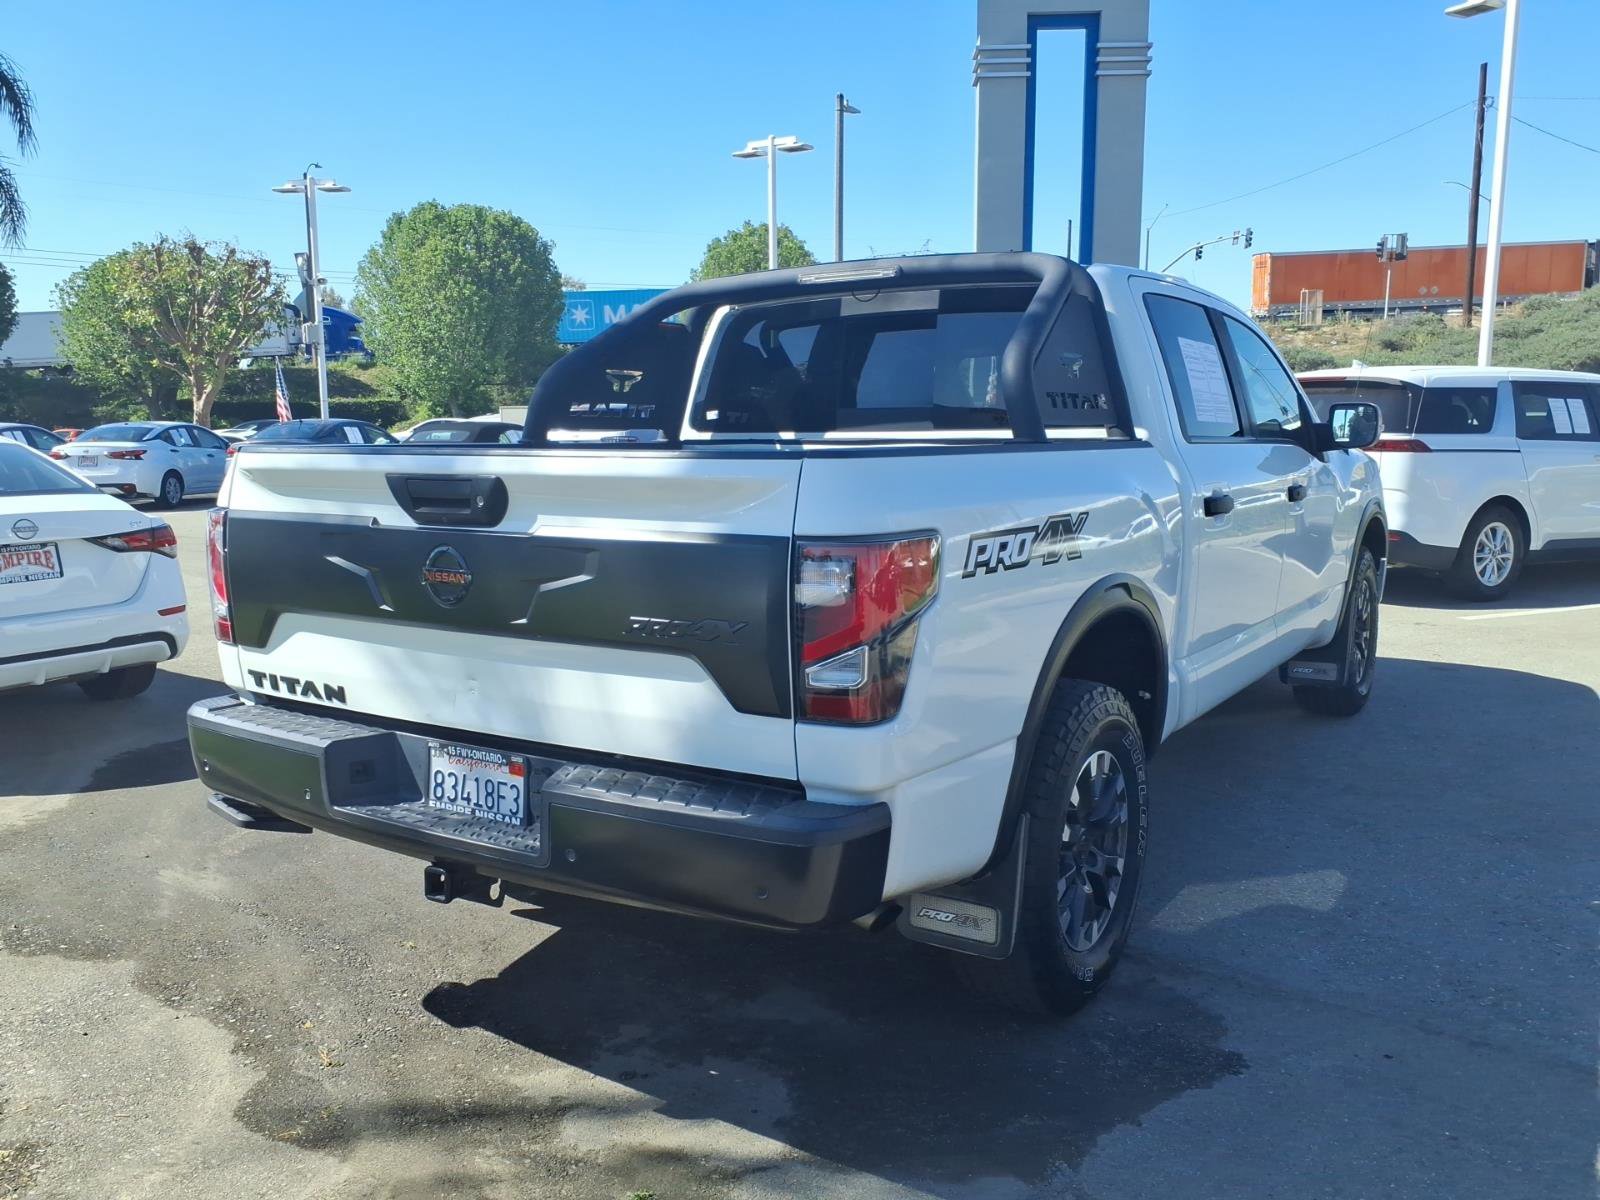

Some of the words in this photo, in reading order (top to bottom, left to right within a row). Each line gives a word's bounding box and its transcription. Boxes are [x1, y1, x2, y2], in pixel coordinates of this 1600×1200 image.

[1046, 391, 1108, 410] TITAN
[424, 571, 466, 584] NISSAN
[247, 668, 347, 705] TITAN
[448, 746, 456, 756] 15
[457, 747, 502, 764] FWY-ONTARIO
[433, 769, 521, 815] 83418F3
